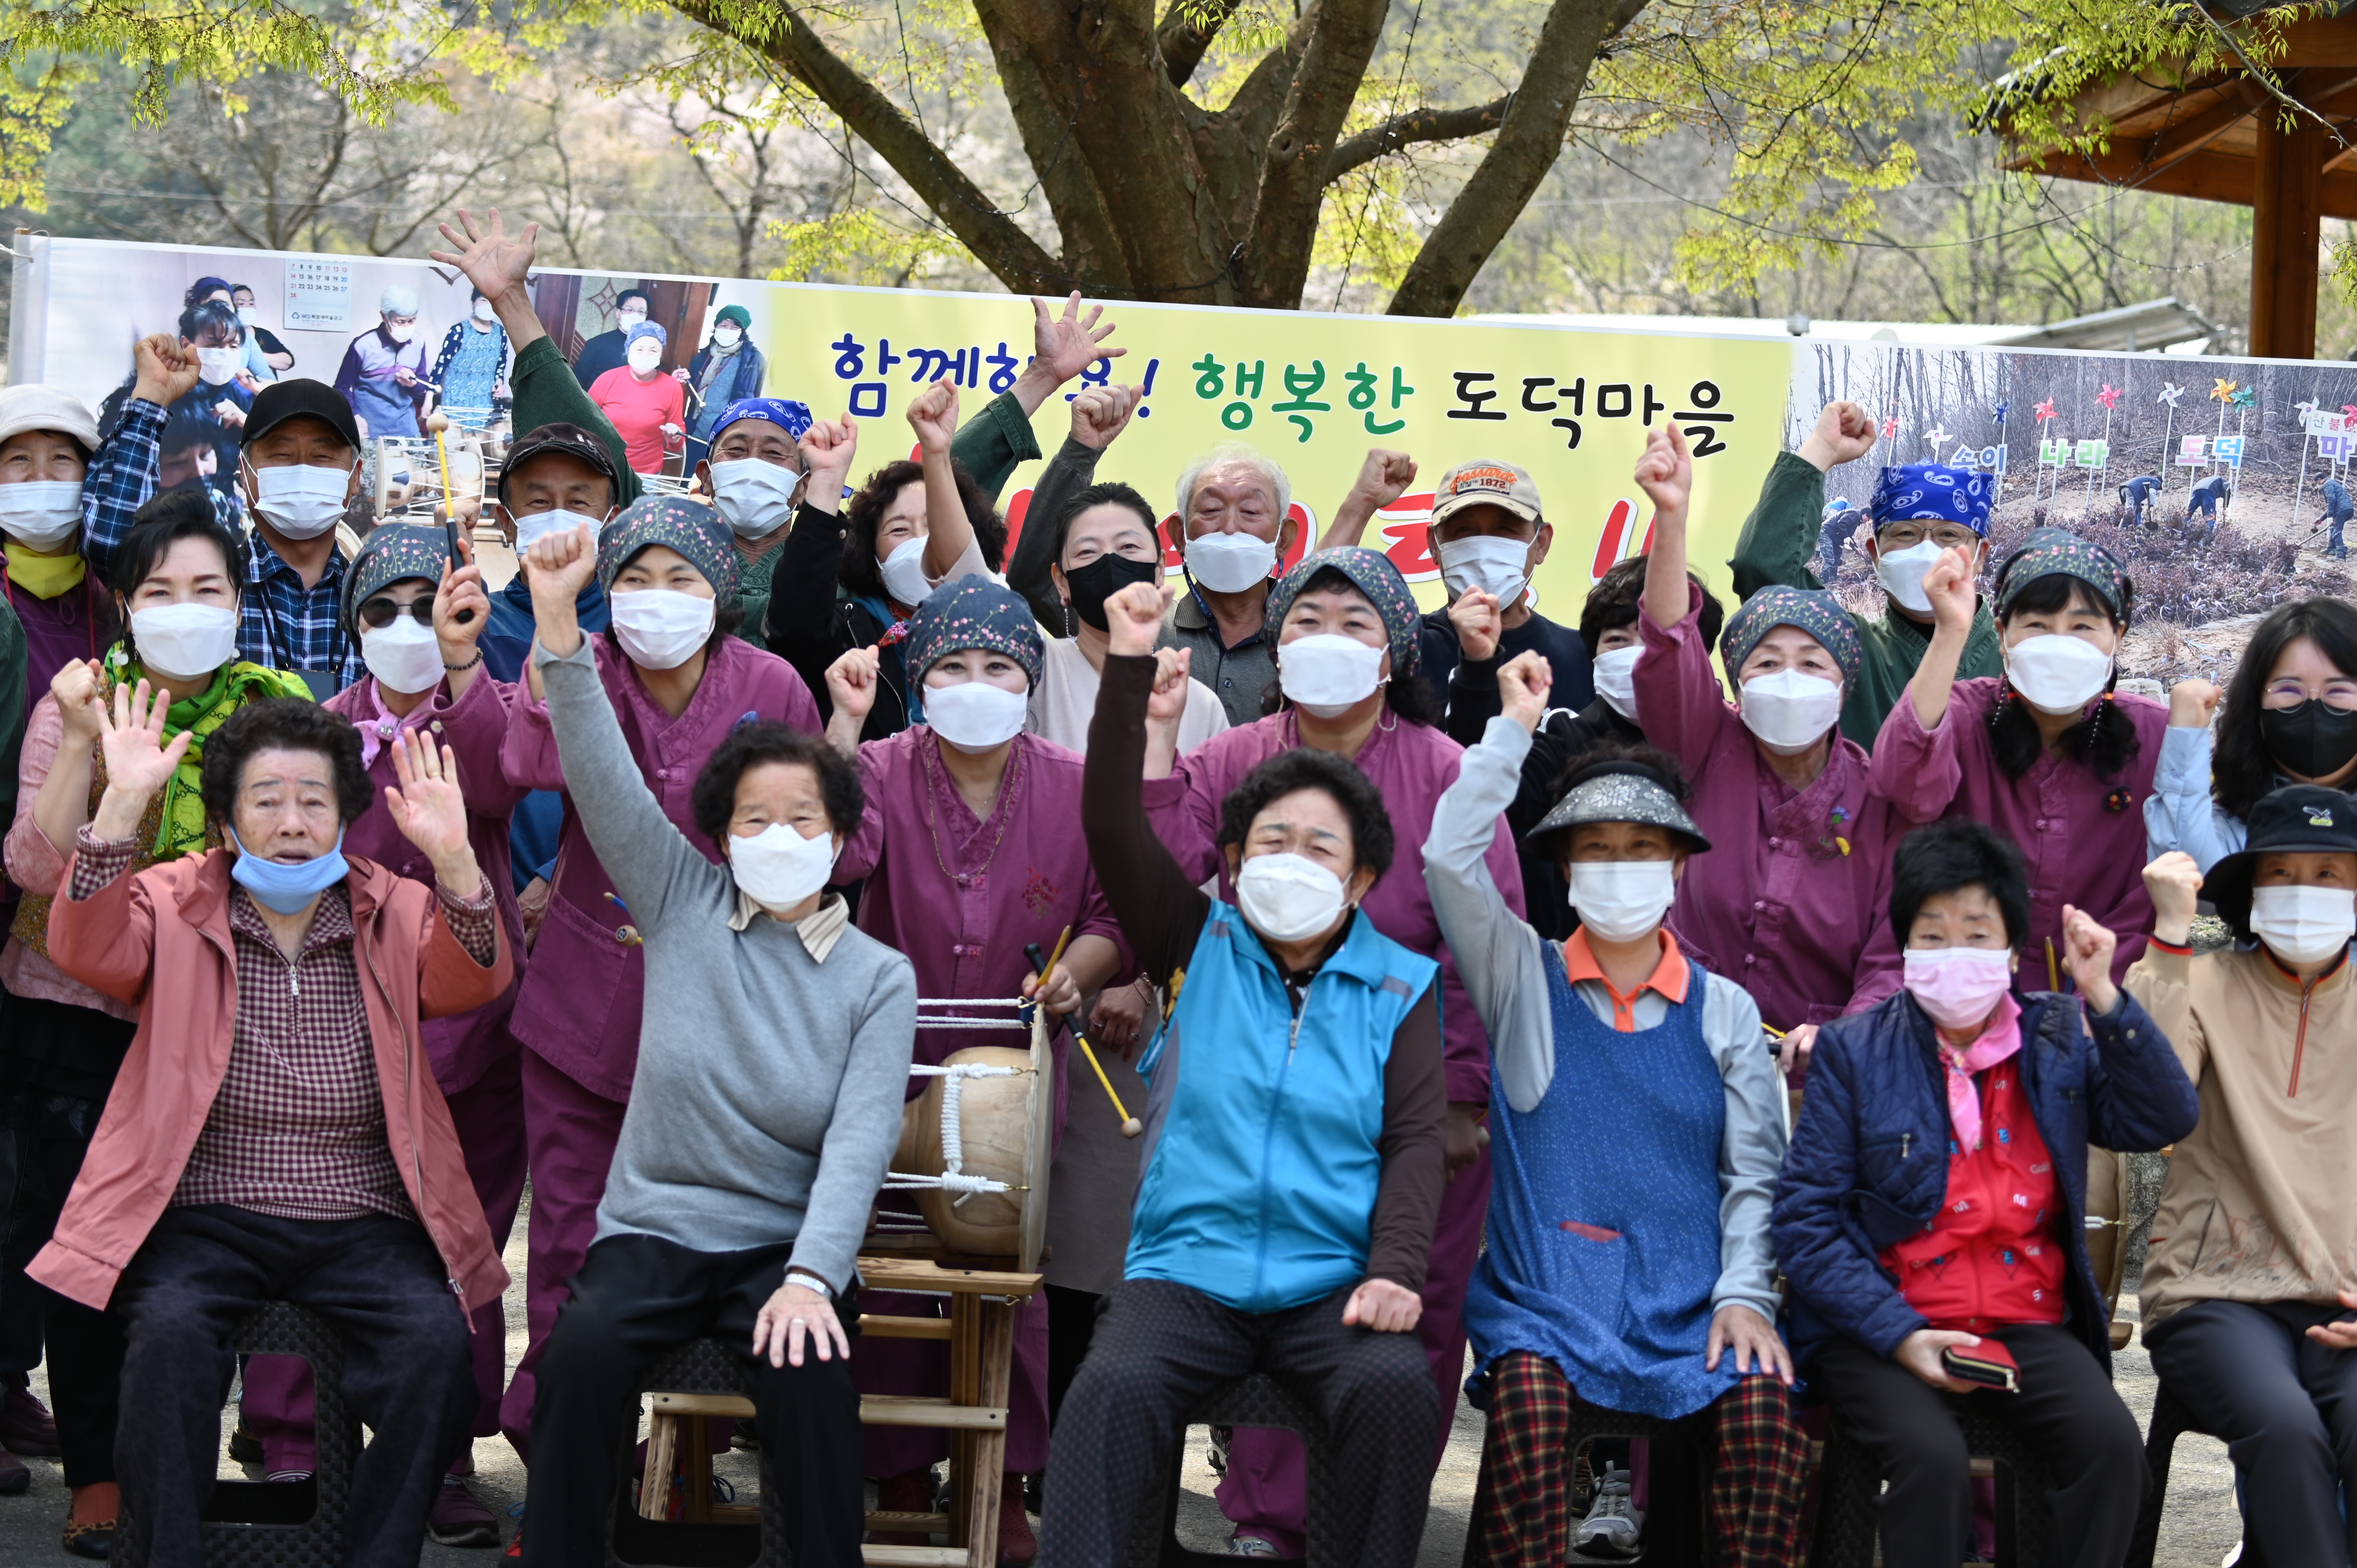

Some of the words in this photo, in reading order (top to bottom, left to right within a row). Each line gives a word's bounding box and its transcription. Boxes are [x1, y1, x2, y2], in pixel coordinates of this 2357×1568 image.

[1192, 353, 1414, 443] 행복한
[1447, 371, 1734, 458] 도덕마을
[2042, 441, 2107, 466] 나라
[2178, 438, 2242, 466] 도덕
[1479, 478, 1506, 489] 1872
